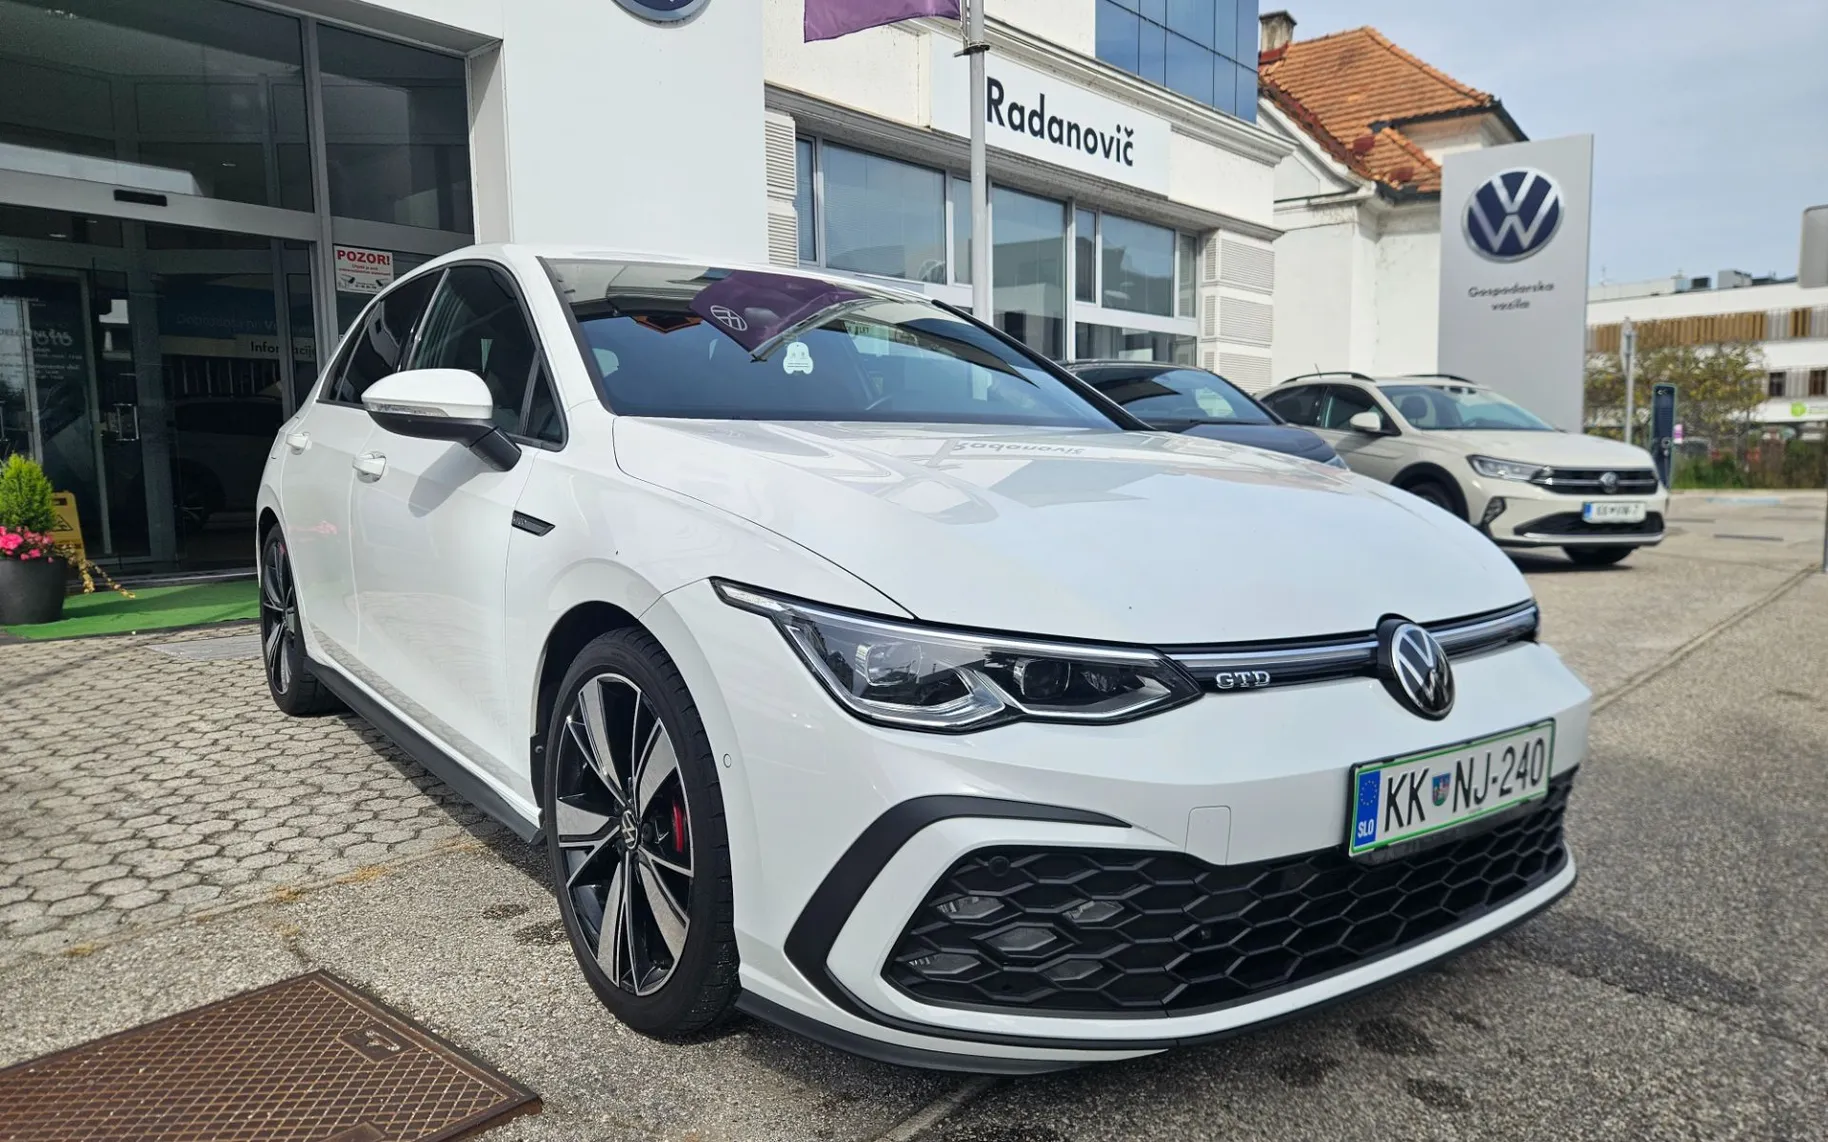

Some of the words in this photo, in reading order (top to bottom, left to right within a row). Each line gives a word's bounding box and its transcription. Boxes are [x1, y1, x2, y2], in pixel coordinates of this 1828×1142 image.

[987, 76, 1134, 167] Radanovič
[337, 250, 390, 265] POZOR!
[1468, 281, 1554, 298] Gospodarska
[1216, 671, 1270, 689] GTD
[1384, 768, 1430, 832] KK
[1452, 737, 1545, 814] NJ-240
[1357, 818, 1375, 838] SLO
